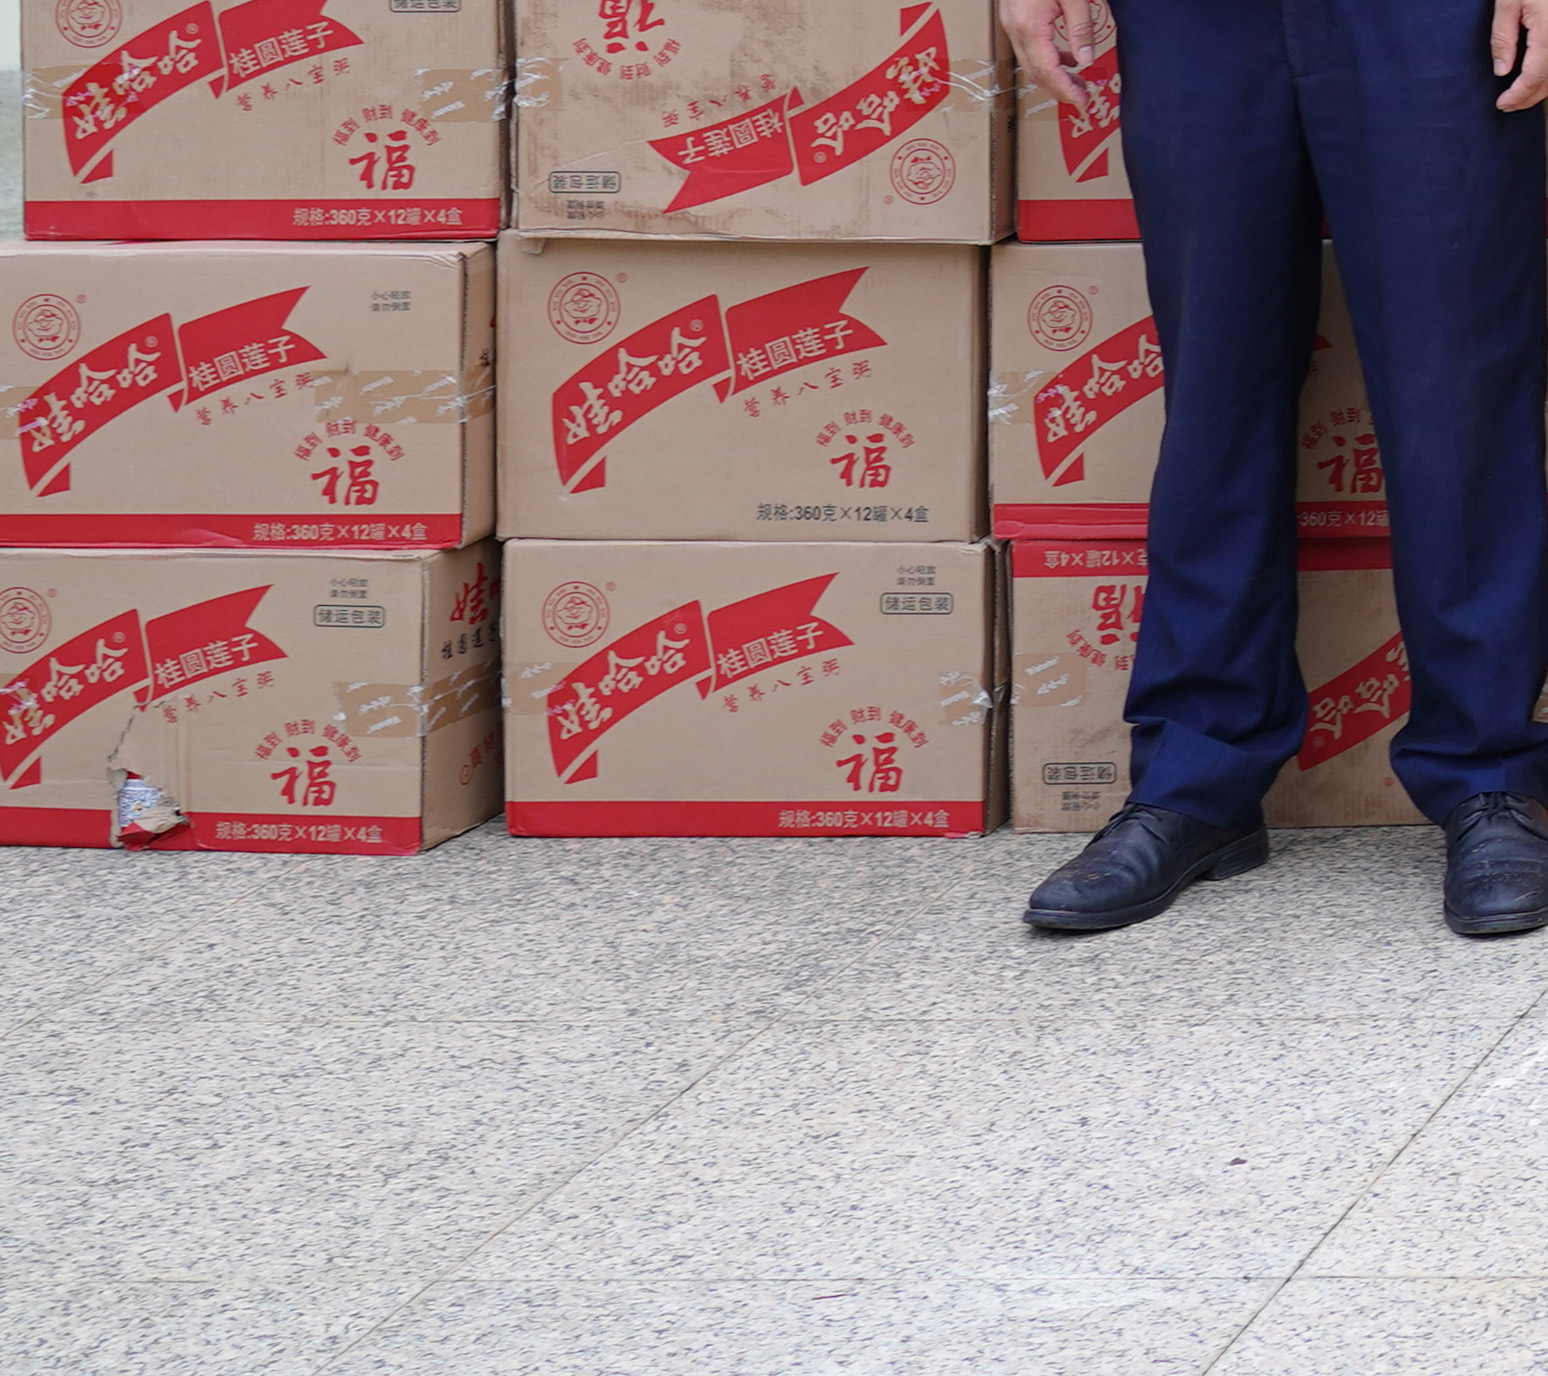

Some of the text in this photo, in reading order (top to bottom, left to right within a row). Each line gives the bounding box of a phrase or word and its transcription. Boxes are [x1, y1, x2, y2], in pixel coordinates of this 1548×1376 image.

[65, 21, 334, 141] 娃哈哈 桂圆莲子
[677, 46, 938, 165] 娃哈哈 桂圆莲子
[348, 131, 417, 191] 福
[30, 334, 296, 453] 娃哈哈 桂圆莲子
[564, 320, 853, 444] 娃哈哈 桂圆莲子
[311, 446, 380, 506] 福
[829, 434, 892, 488] 福
[1317, 434, 1384, 493] 福
[2, 633, 259, 745] 娃哈哈 桂圆莲子
[559, 622, 824, 740] 娃哈哈 桂圆莲子
[271, 746, 338, 807] 福
[836, 732, 904, 793] 福
